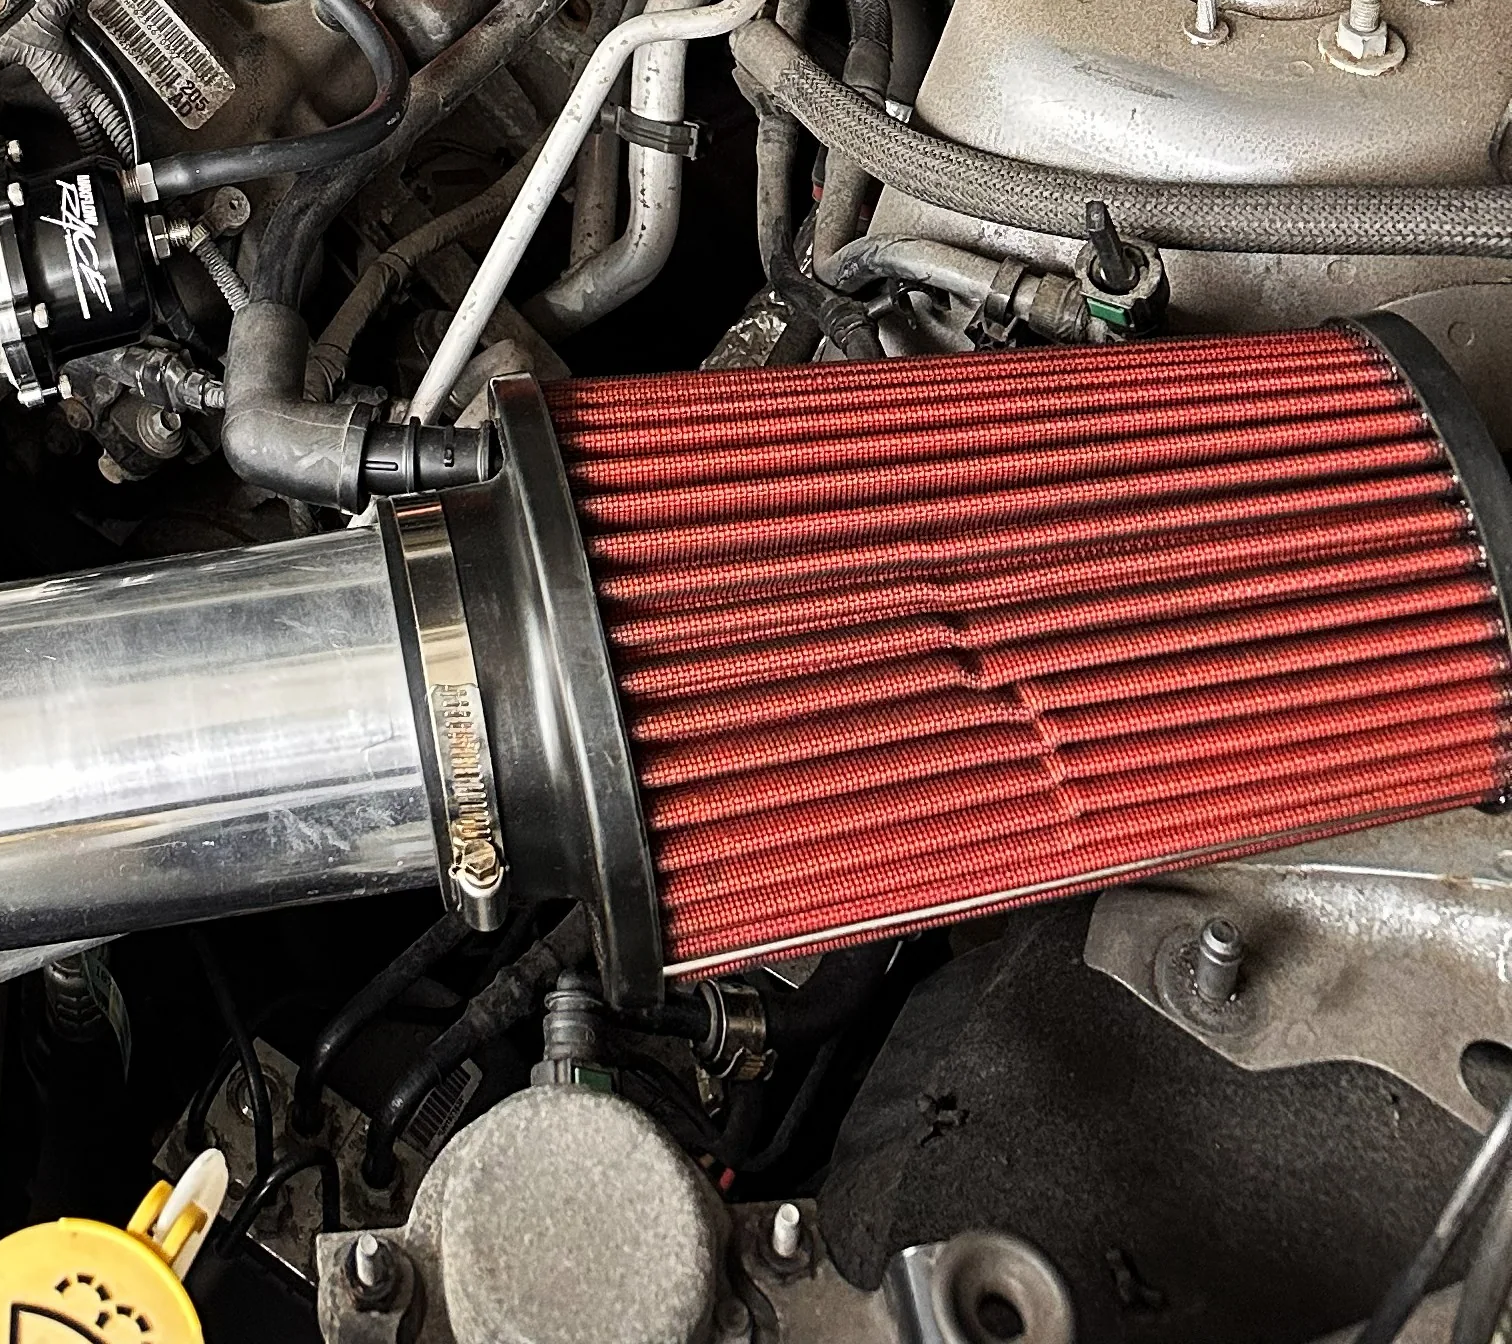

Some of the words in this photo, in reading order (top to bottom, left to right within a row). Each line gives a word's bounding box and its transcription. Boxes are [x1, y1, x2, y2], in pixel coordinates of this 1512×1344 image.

[167, 90, 194, 119] AD
[178, 77, 211, 113] 205
[76, 174, 98, 225] MAXFLOW
[39, 180, 112, 311] RACE
